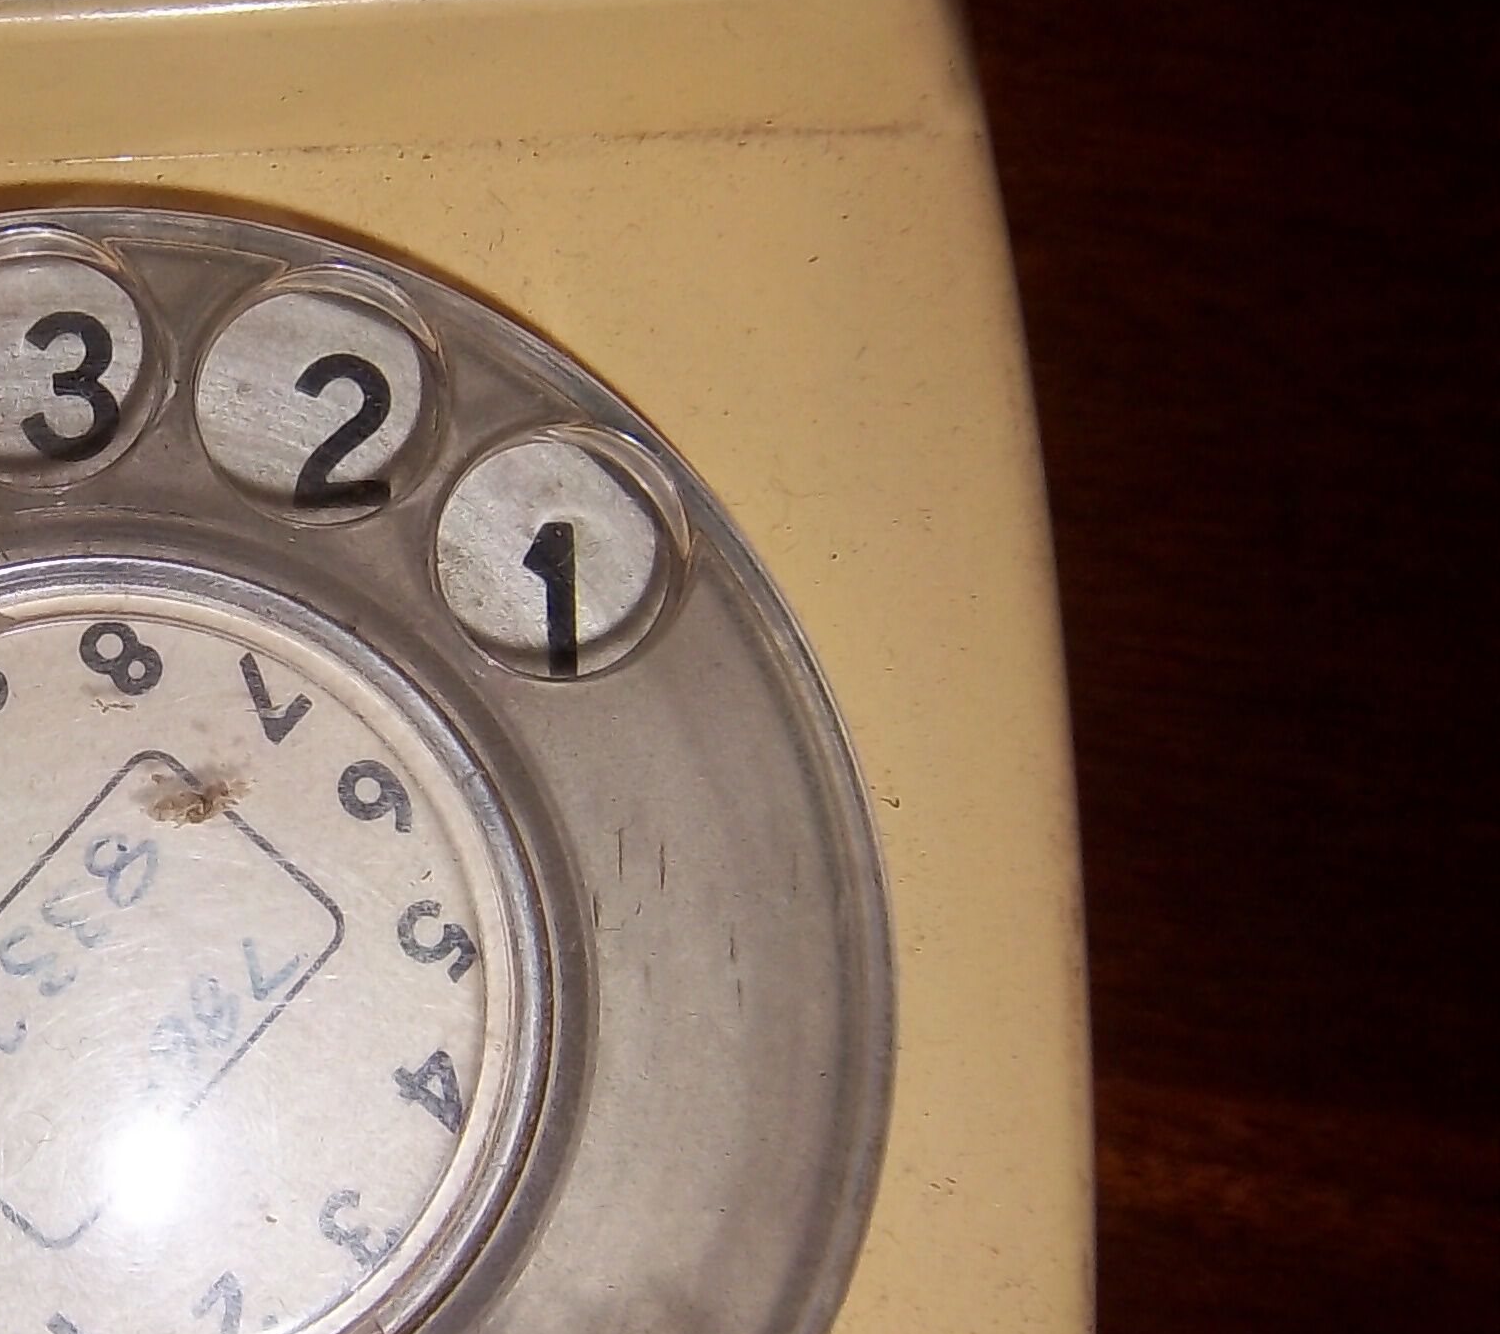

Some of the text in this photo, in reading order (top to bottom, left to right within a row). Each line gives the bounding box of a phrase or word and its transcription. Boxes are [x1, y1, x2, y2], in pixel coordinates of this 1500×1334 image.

[21, 311, 120, 462] 3
[294, 353, 391, 507] 2
[523, 522, 577, 675] 1
[80, 622, 163, 695] 8
[398, 899, 476, 983] 5
[394, 1051, 462, 1133] 4
[318, 1188, 400, 1267] 3
